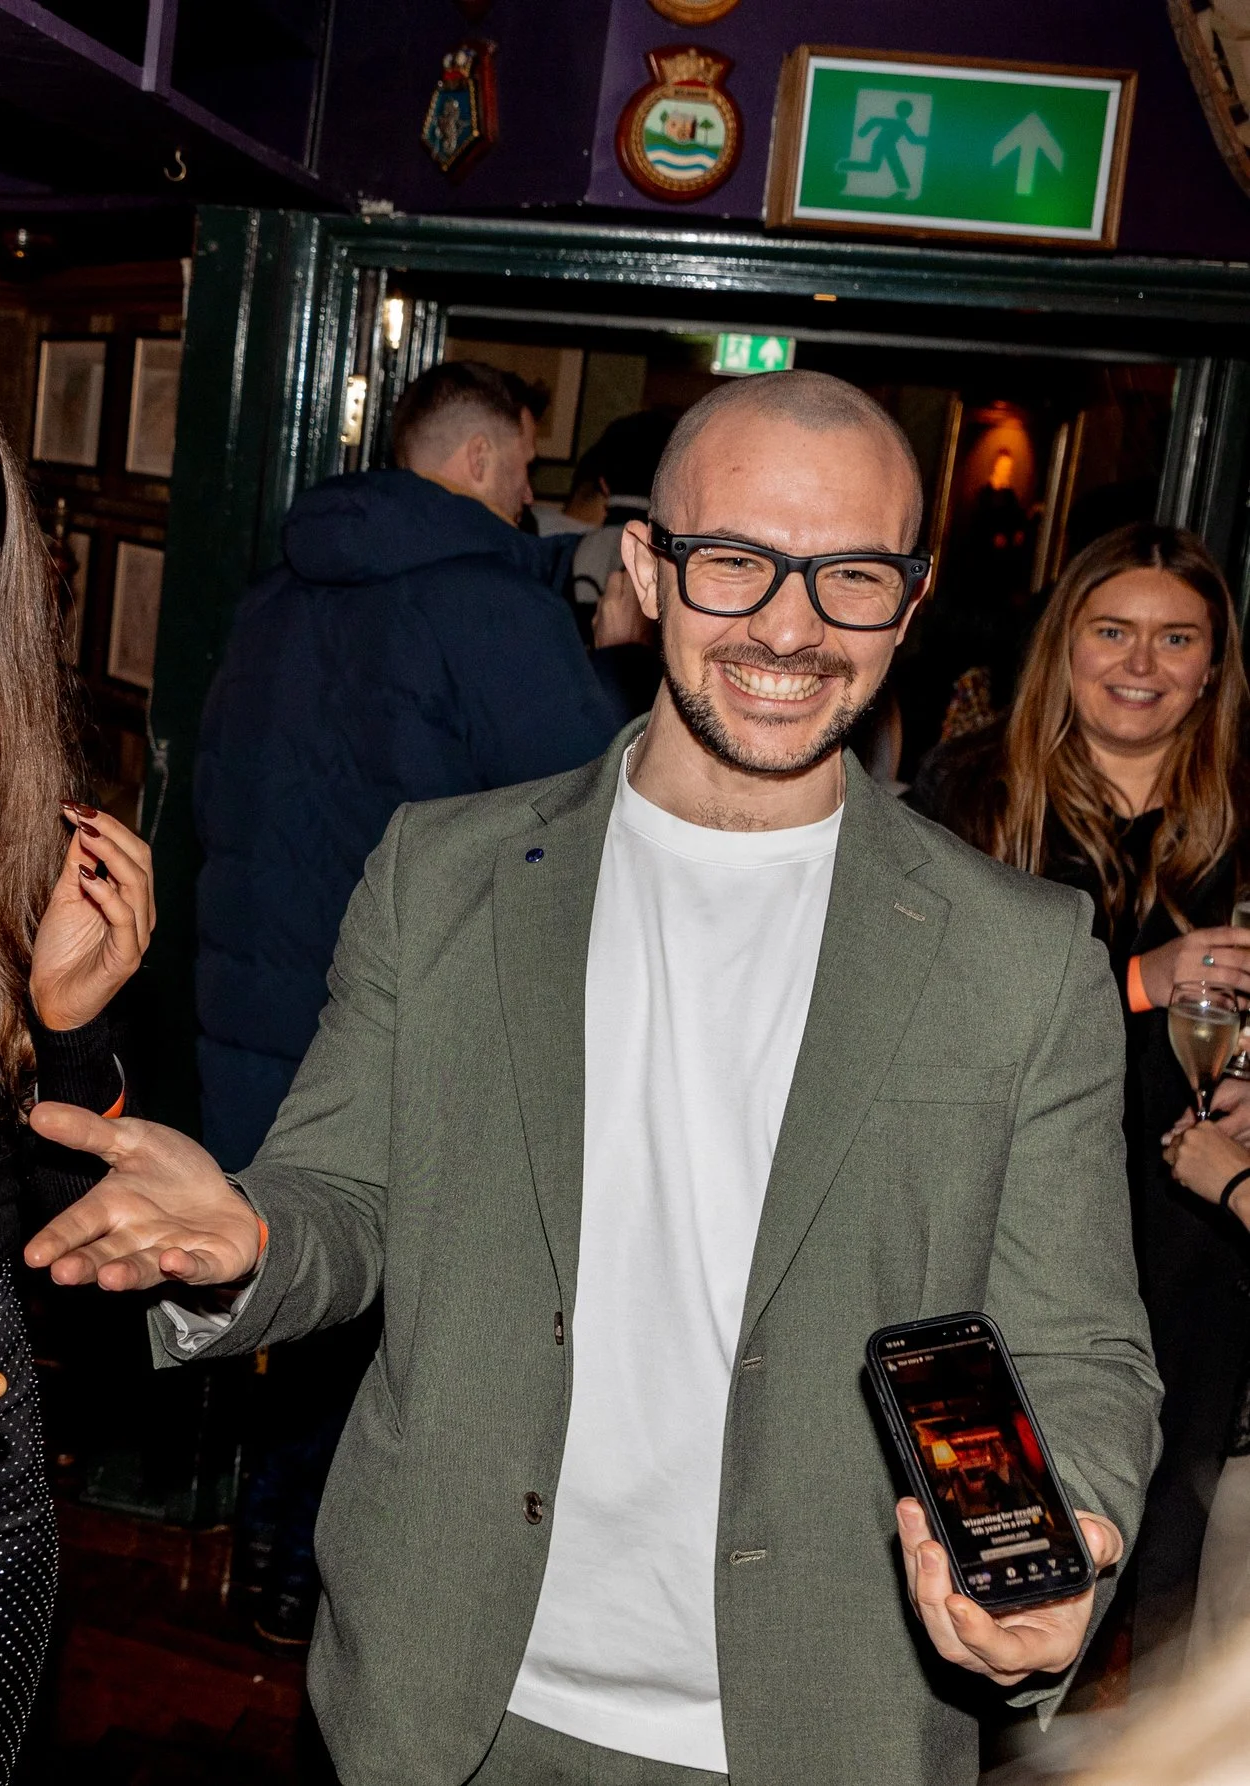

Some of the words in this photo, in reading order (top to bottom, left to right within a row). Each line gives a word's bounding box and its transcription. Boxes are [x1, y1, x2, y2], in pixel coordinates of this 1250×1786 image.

[962, 1513, 1002, 1528] Wizarding
[1001, 1512, 1013, 1522] for
[985, 1524, 1002, 1536] year
[1002, 1521, 1011, 1530] in
[1011, 1520, 1017, 1529] a
[1017, 1518, 1031, 1528] row
